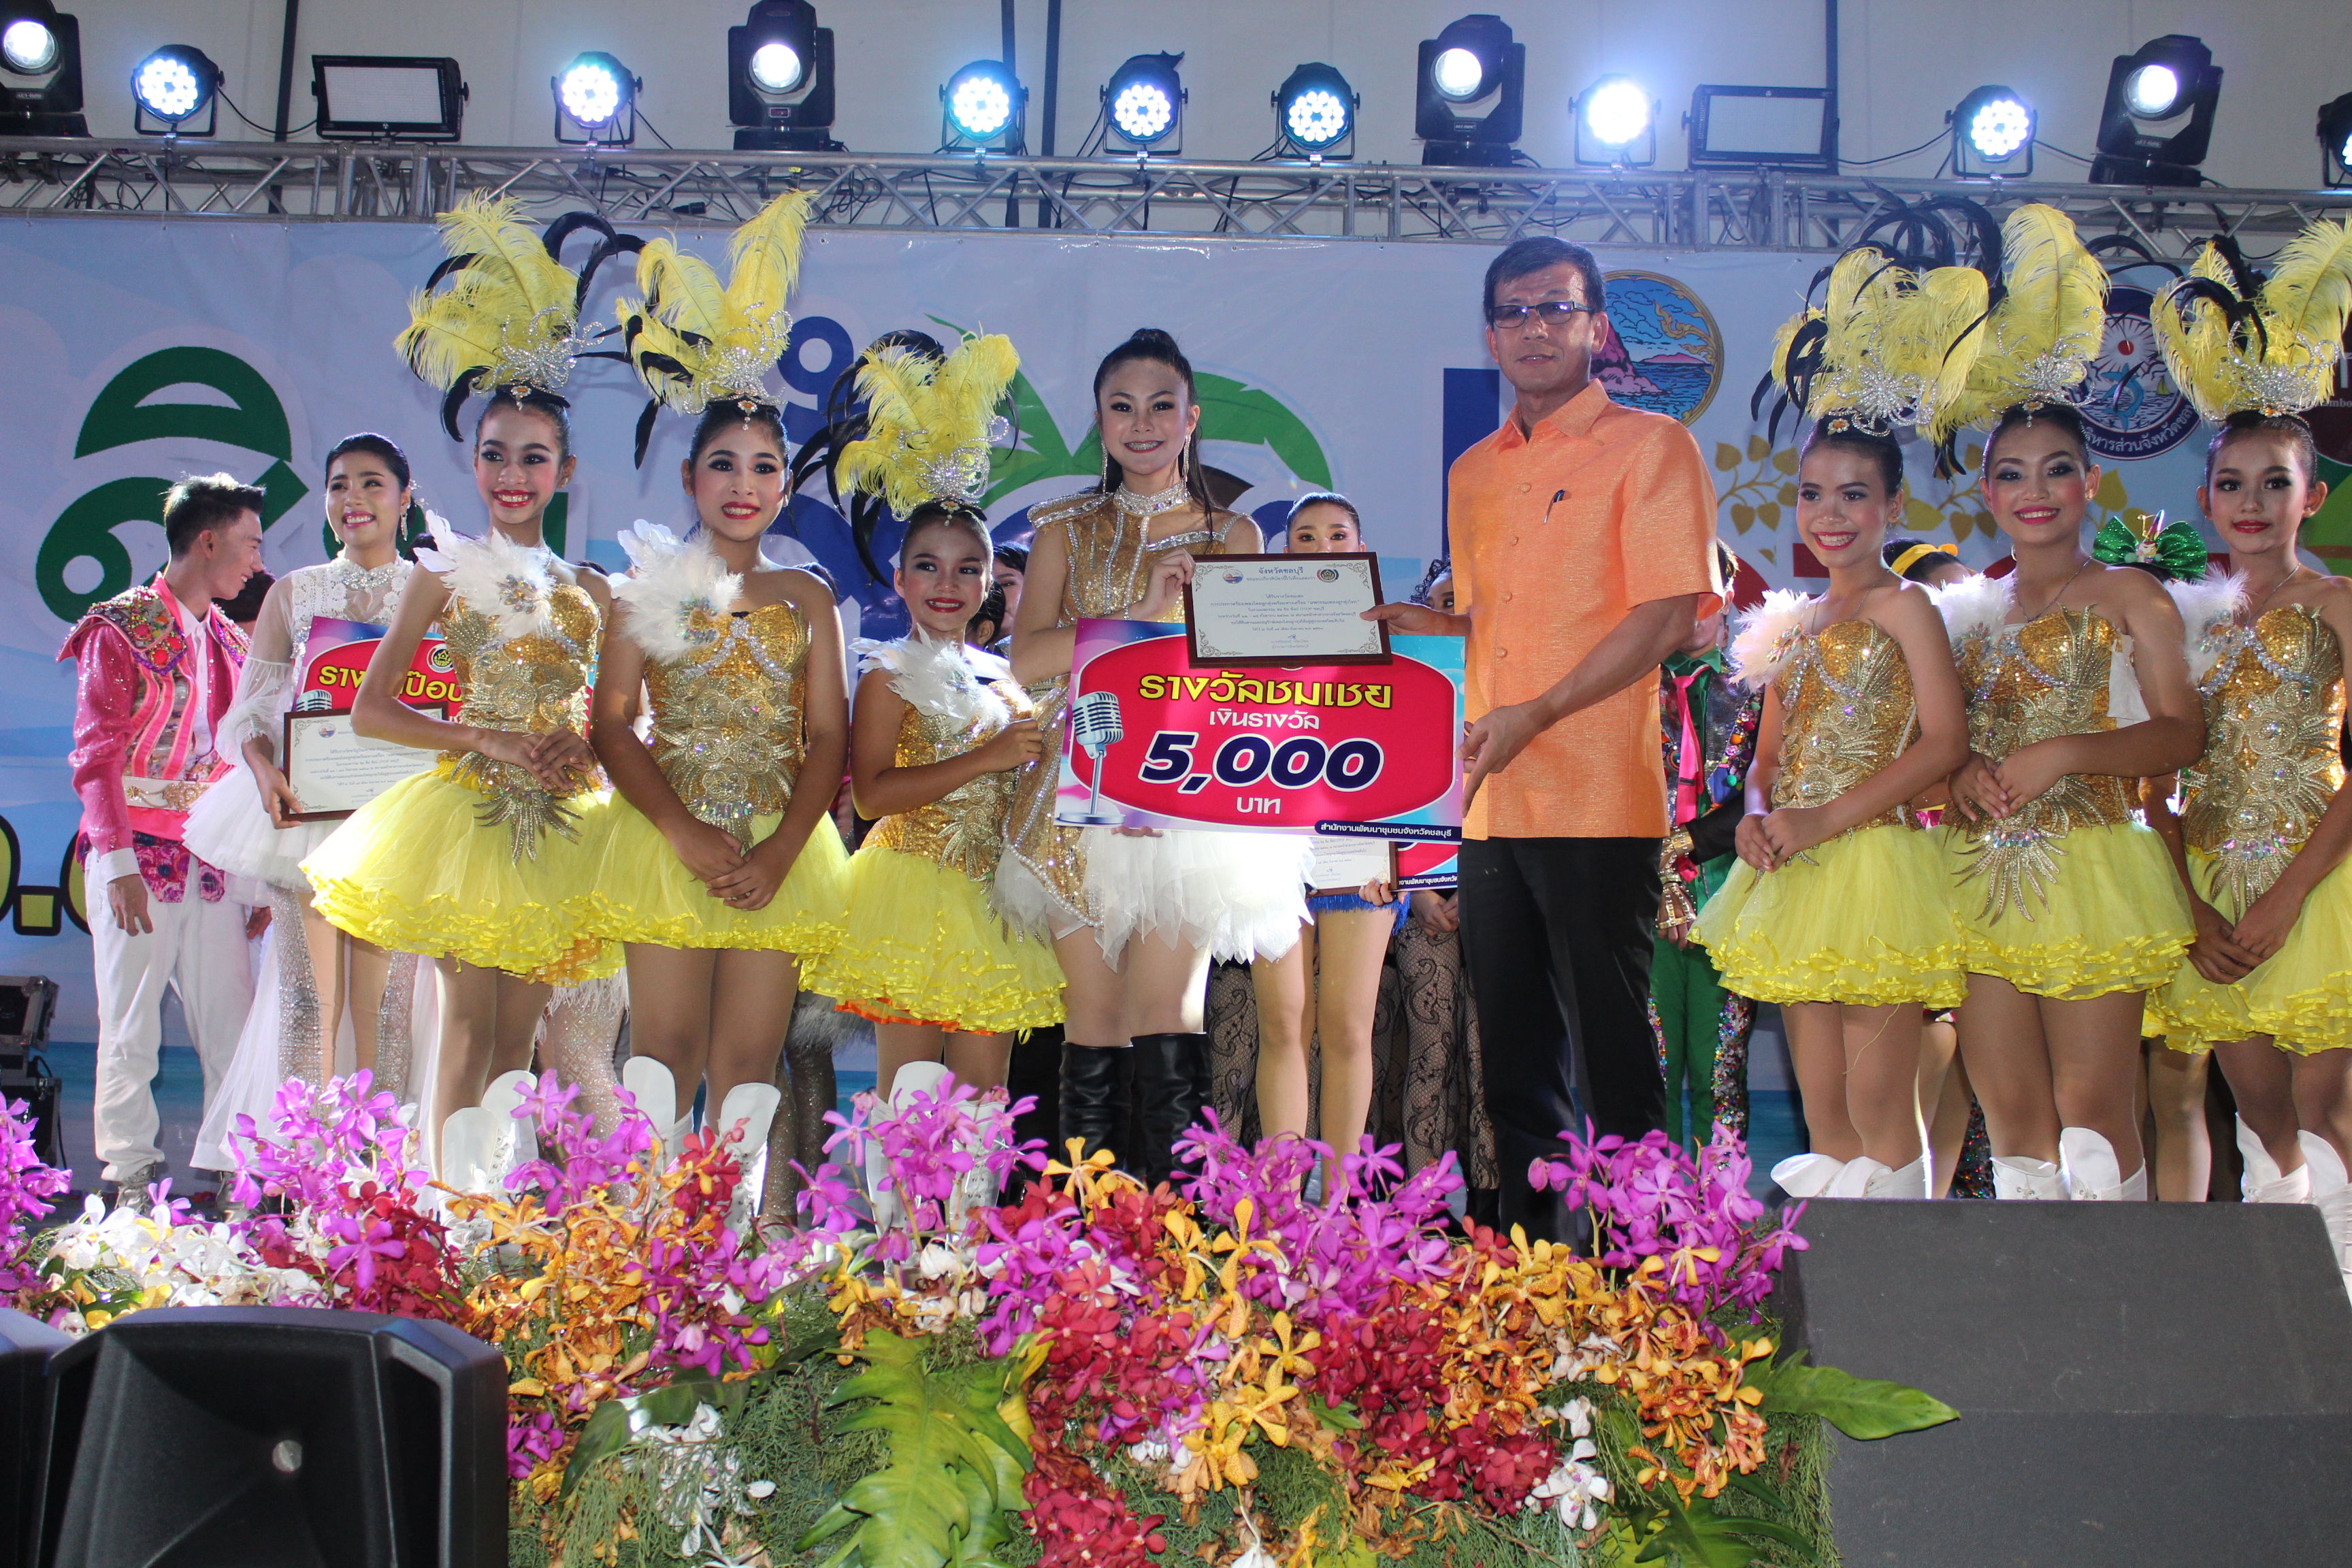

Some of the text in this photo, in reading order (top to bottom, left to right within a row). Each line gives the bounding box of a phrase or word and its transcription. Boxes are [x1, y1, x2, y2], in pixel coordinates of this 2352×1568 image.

[1258, 566, 1303, 576] จังหวัดชลบุรี
[1139, 670, 1393, 709] รางวัลชมเชย
[1209, 708, 1320, 730] เงินรางวัล
[1137, 730, 1384, 794] 5,000
[1237, 796, 1281, 815] บาท
[1320, 823, 1452, 839] สำนักงานพัฒนาชุมชนจังหวัดชลบุรี
